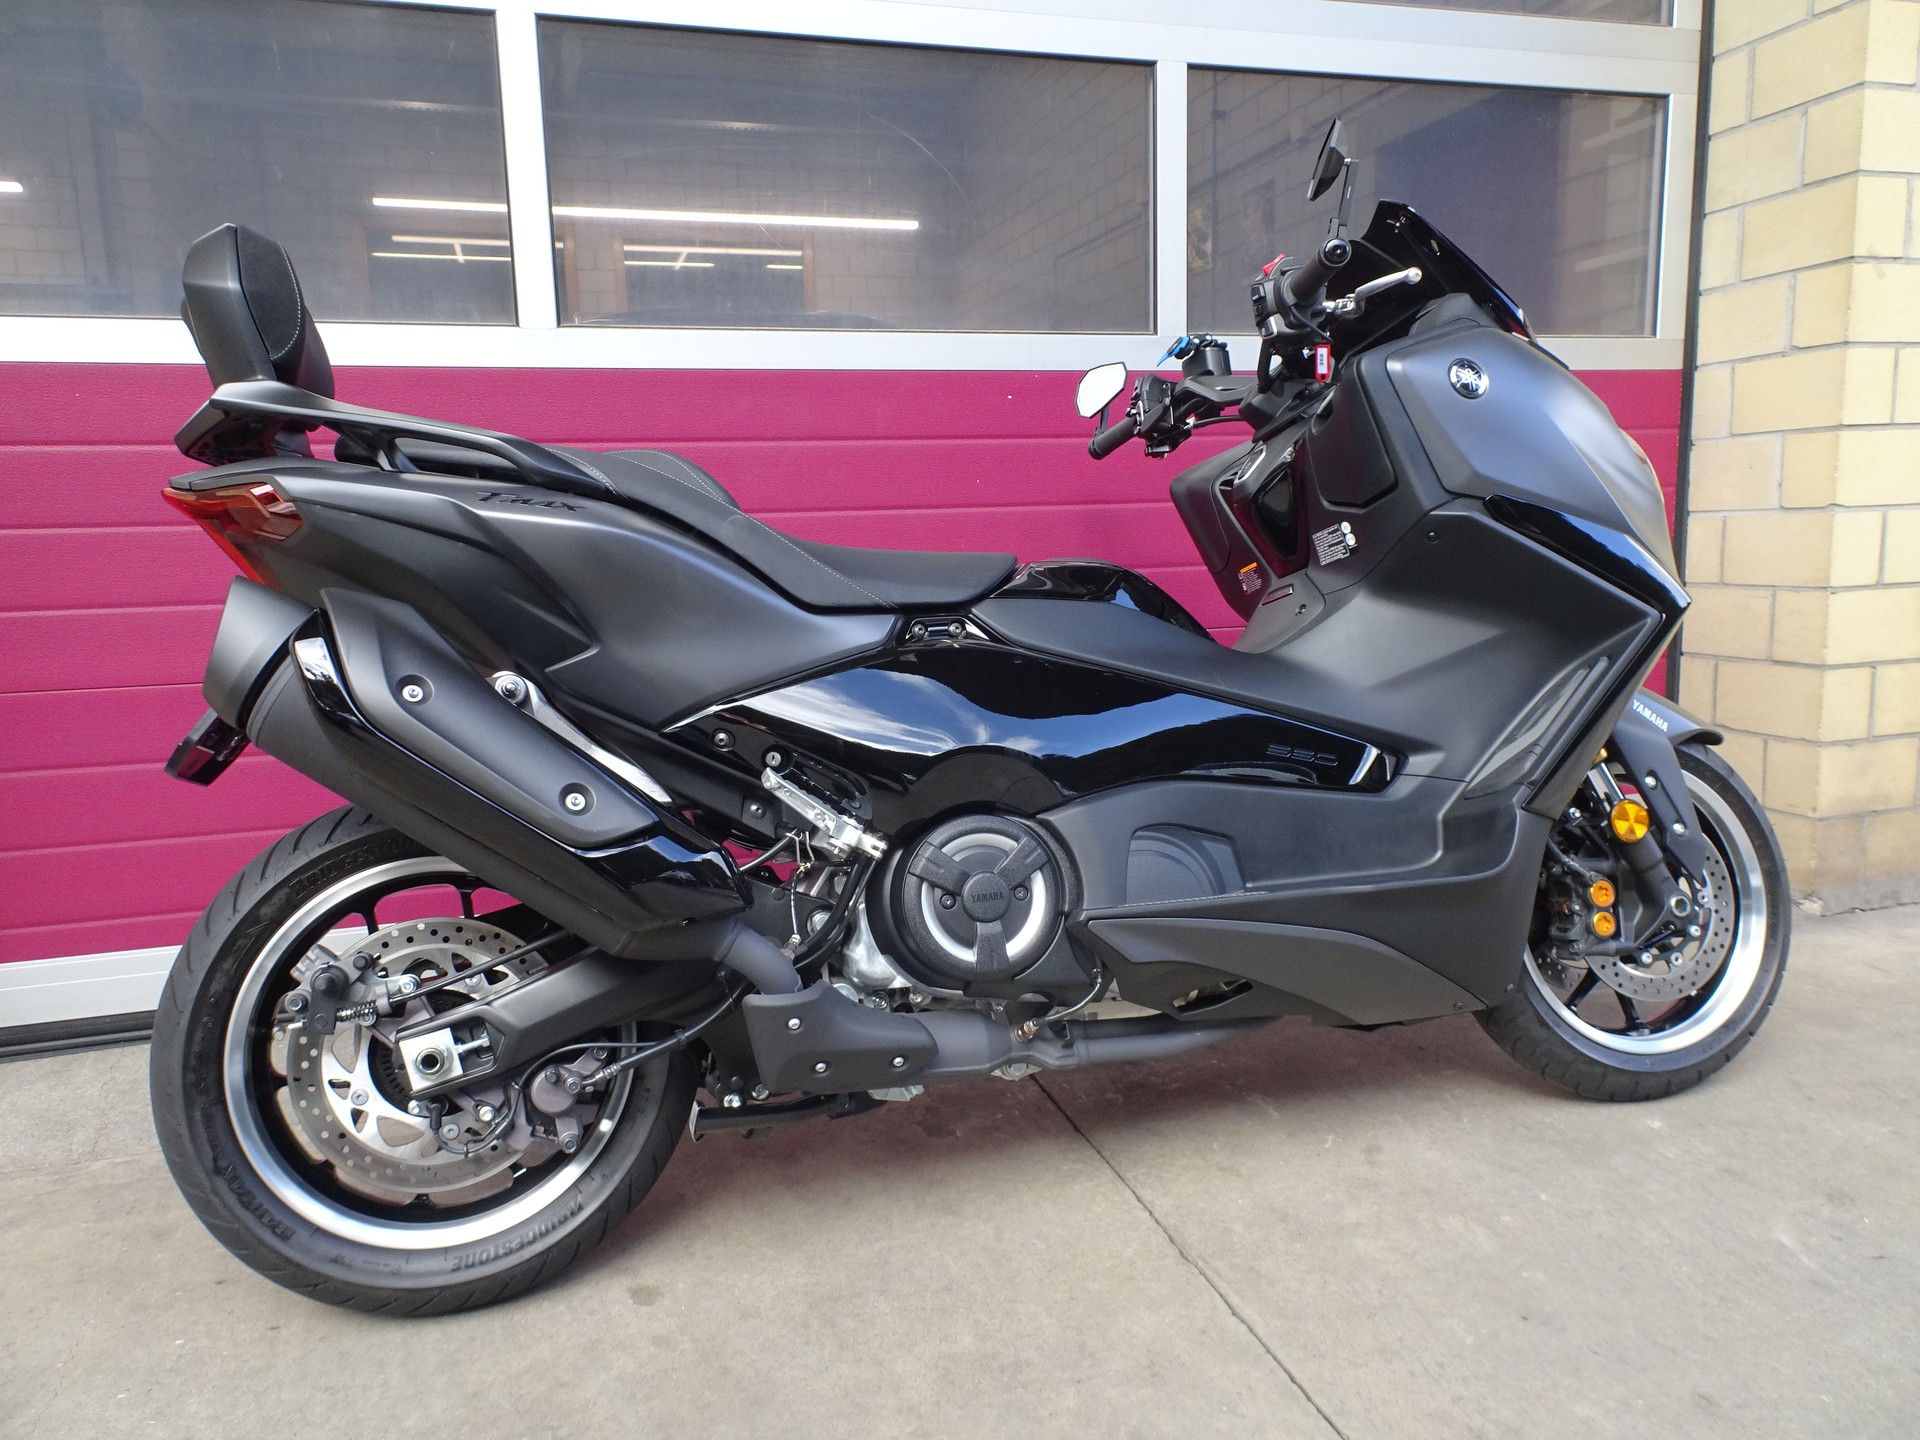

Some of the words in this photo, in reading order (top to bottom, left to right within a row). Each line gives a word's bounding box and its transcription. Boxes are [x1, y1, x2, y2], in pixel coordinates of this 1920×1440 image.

[1632, 699, 1668, 732] YAMAHA
[971, 891, 1005, 903] YAMAHA
[450, 1194, 584, 1273] BRIDGESTONE
